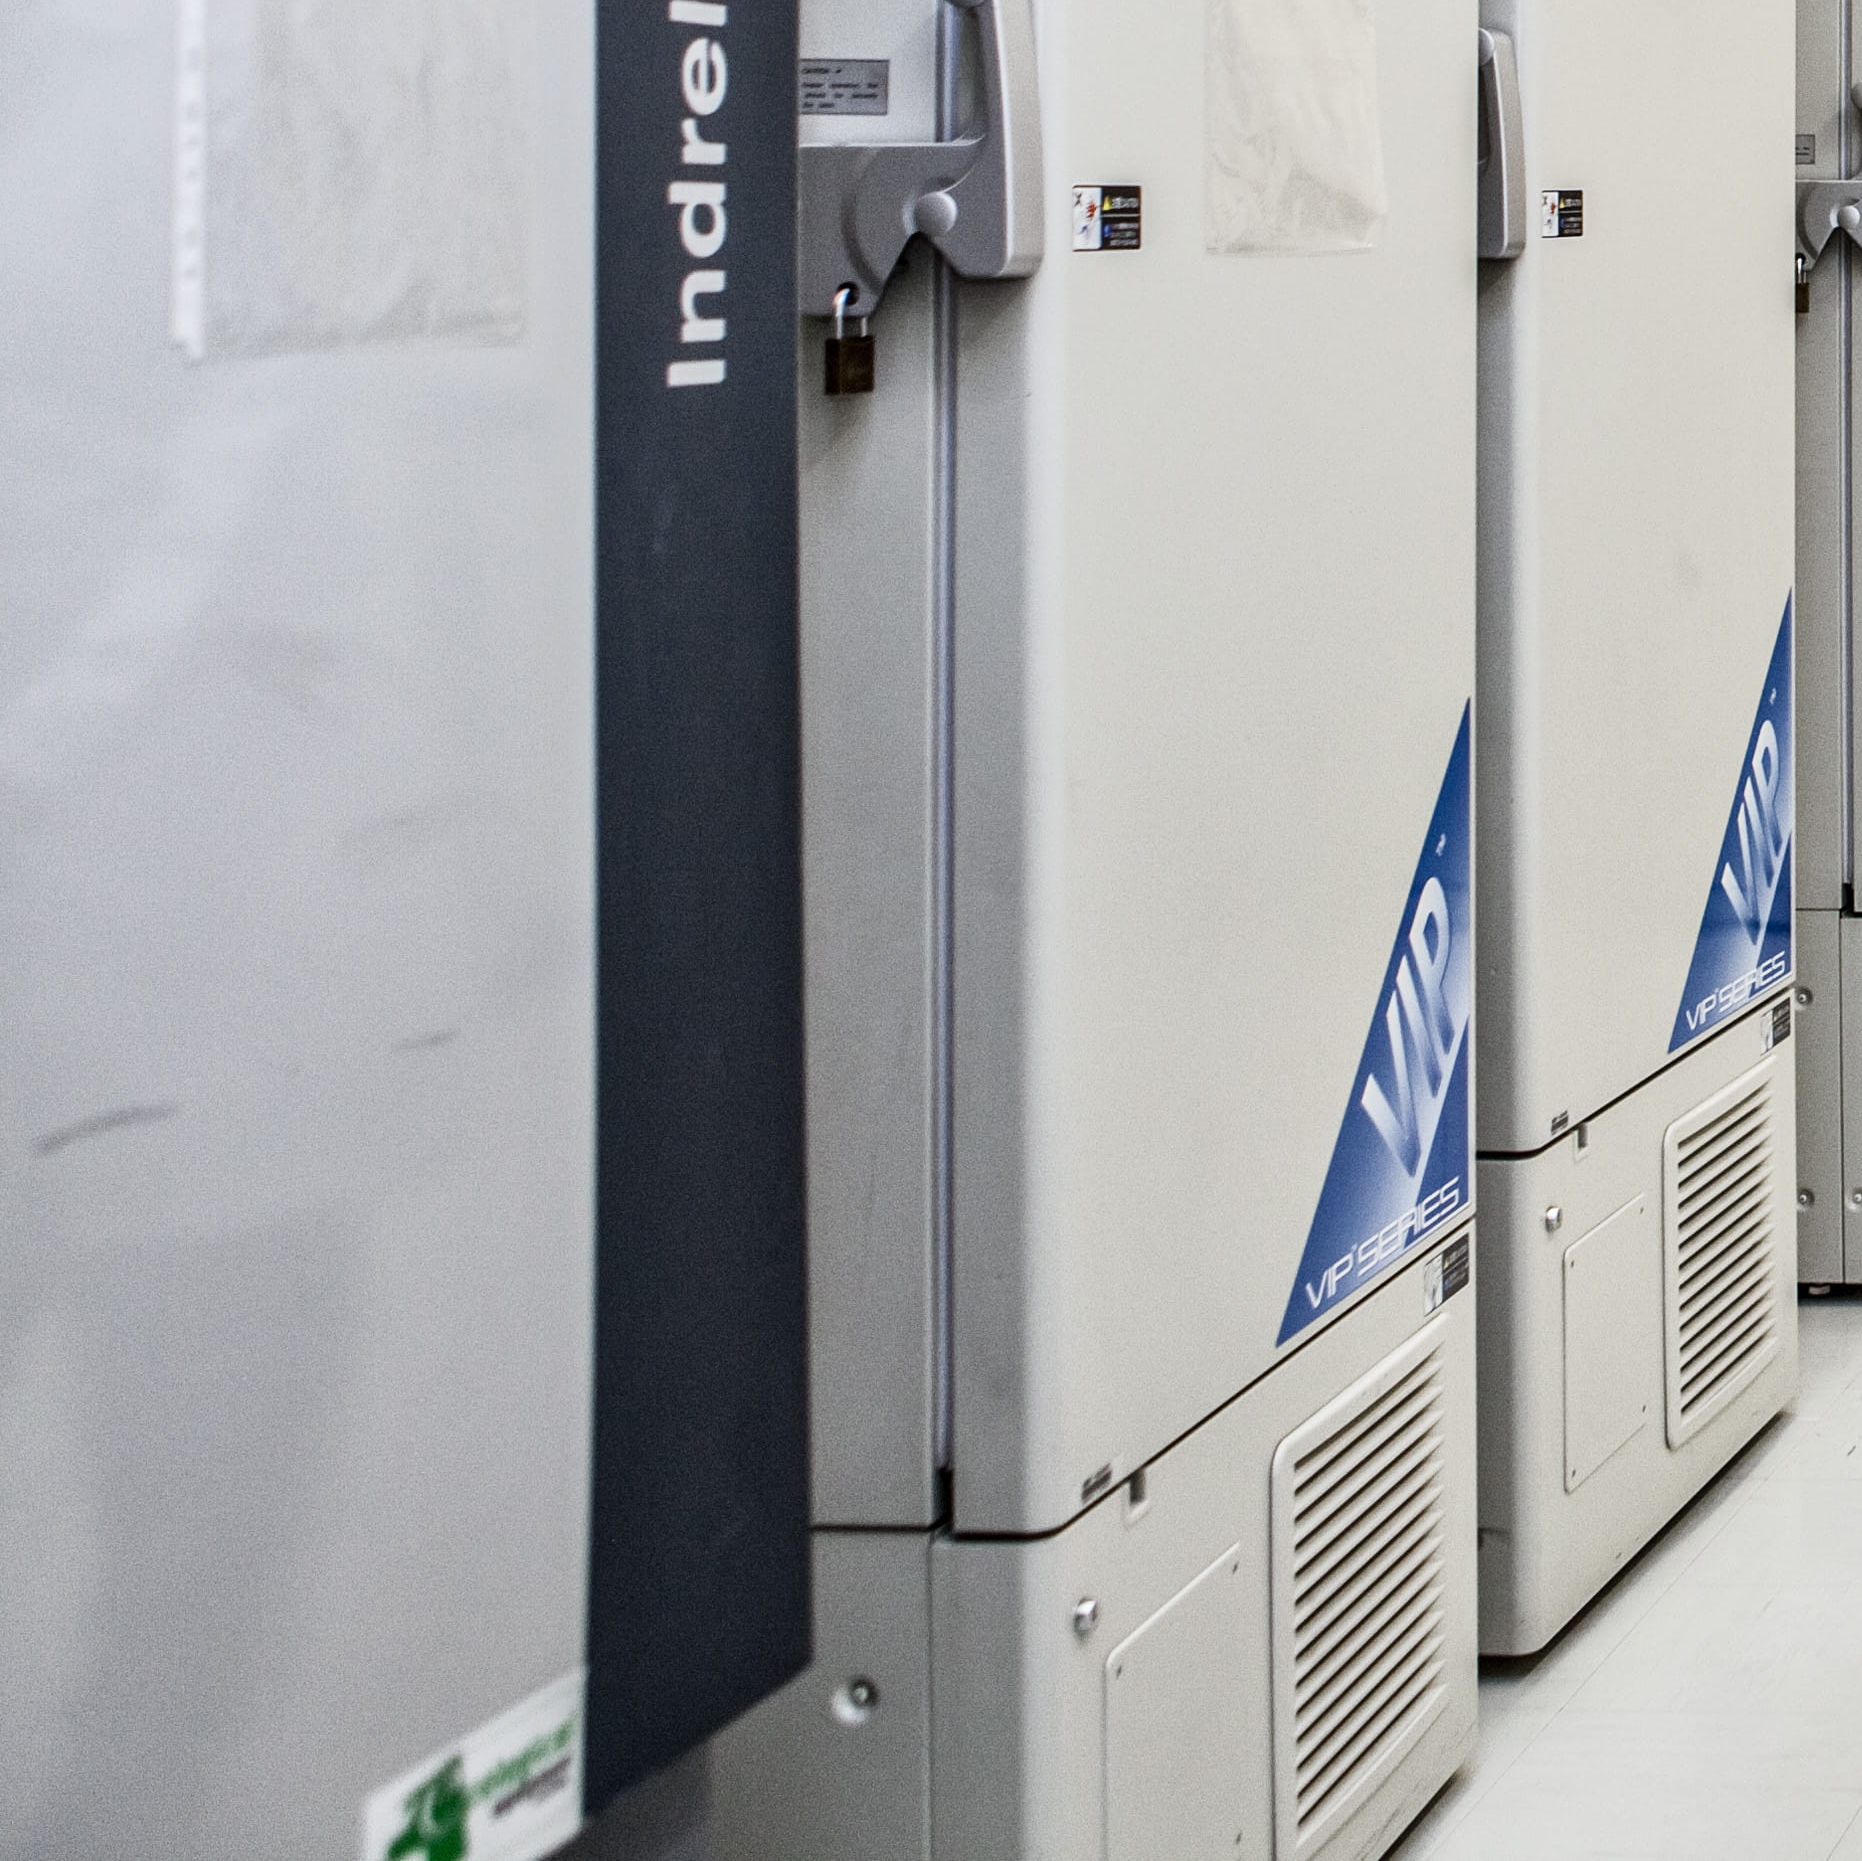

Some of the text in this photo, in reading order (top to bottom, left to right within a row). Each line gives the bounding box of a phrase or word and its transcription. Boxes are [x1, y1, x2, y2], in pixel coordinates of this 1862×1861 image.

[1360, 875, 1456, 1179] VIP
[1684, 950, 1787, 1032] VIP SERIES
[1304, 1176, 1461, 1311] VIP SERIES
